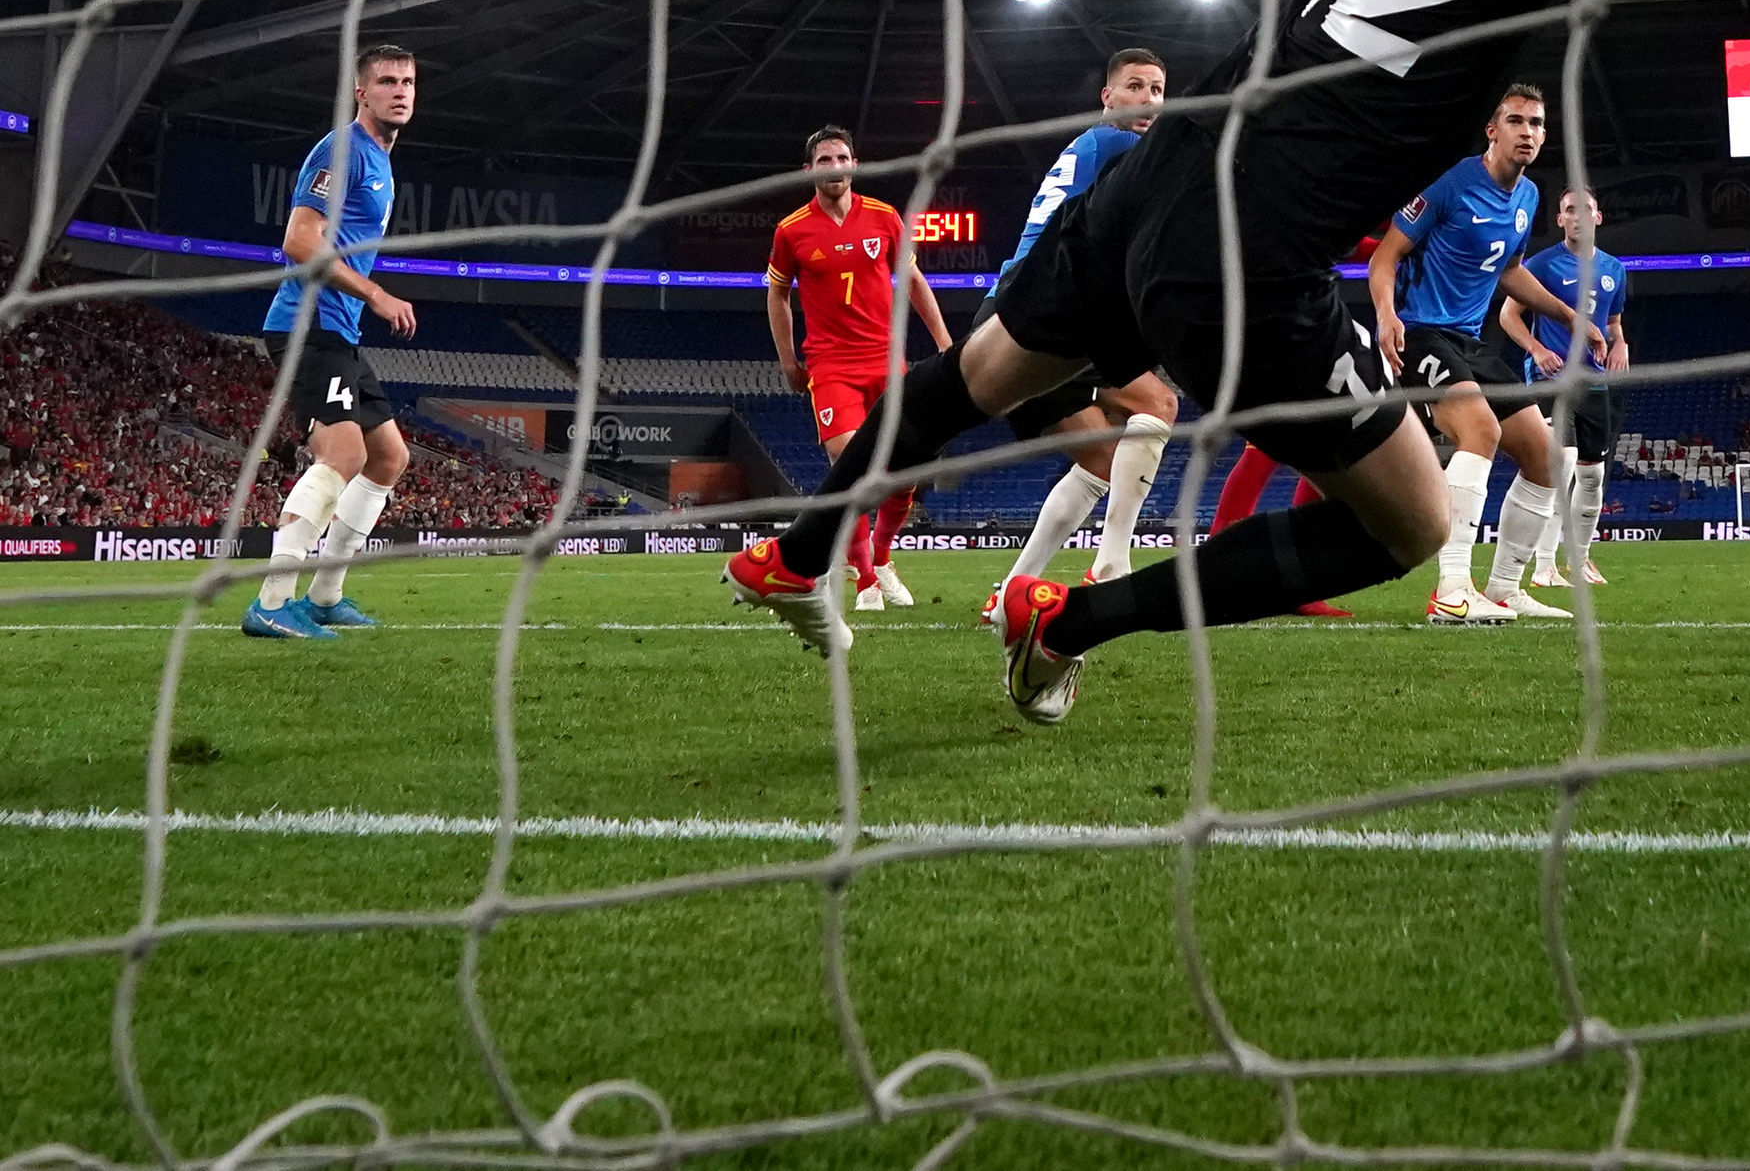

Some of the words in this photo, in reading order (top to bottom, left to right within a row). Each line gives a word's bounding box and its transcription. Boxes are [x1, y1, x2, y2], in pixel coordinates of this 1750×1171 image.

[1480, 241, 1506, 272] 2
[840, 272, 855, 306] 7
[1417, 353, 1451, 390] 2
[326, 376, 354, 410] 4
[4, 539, 62, 556] QUALIFIERS
[95, 531, 197, 562] Hisense
[645, 531, 697, 555] Hisense
